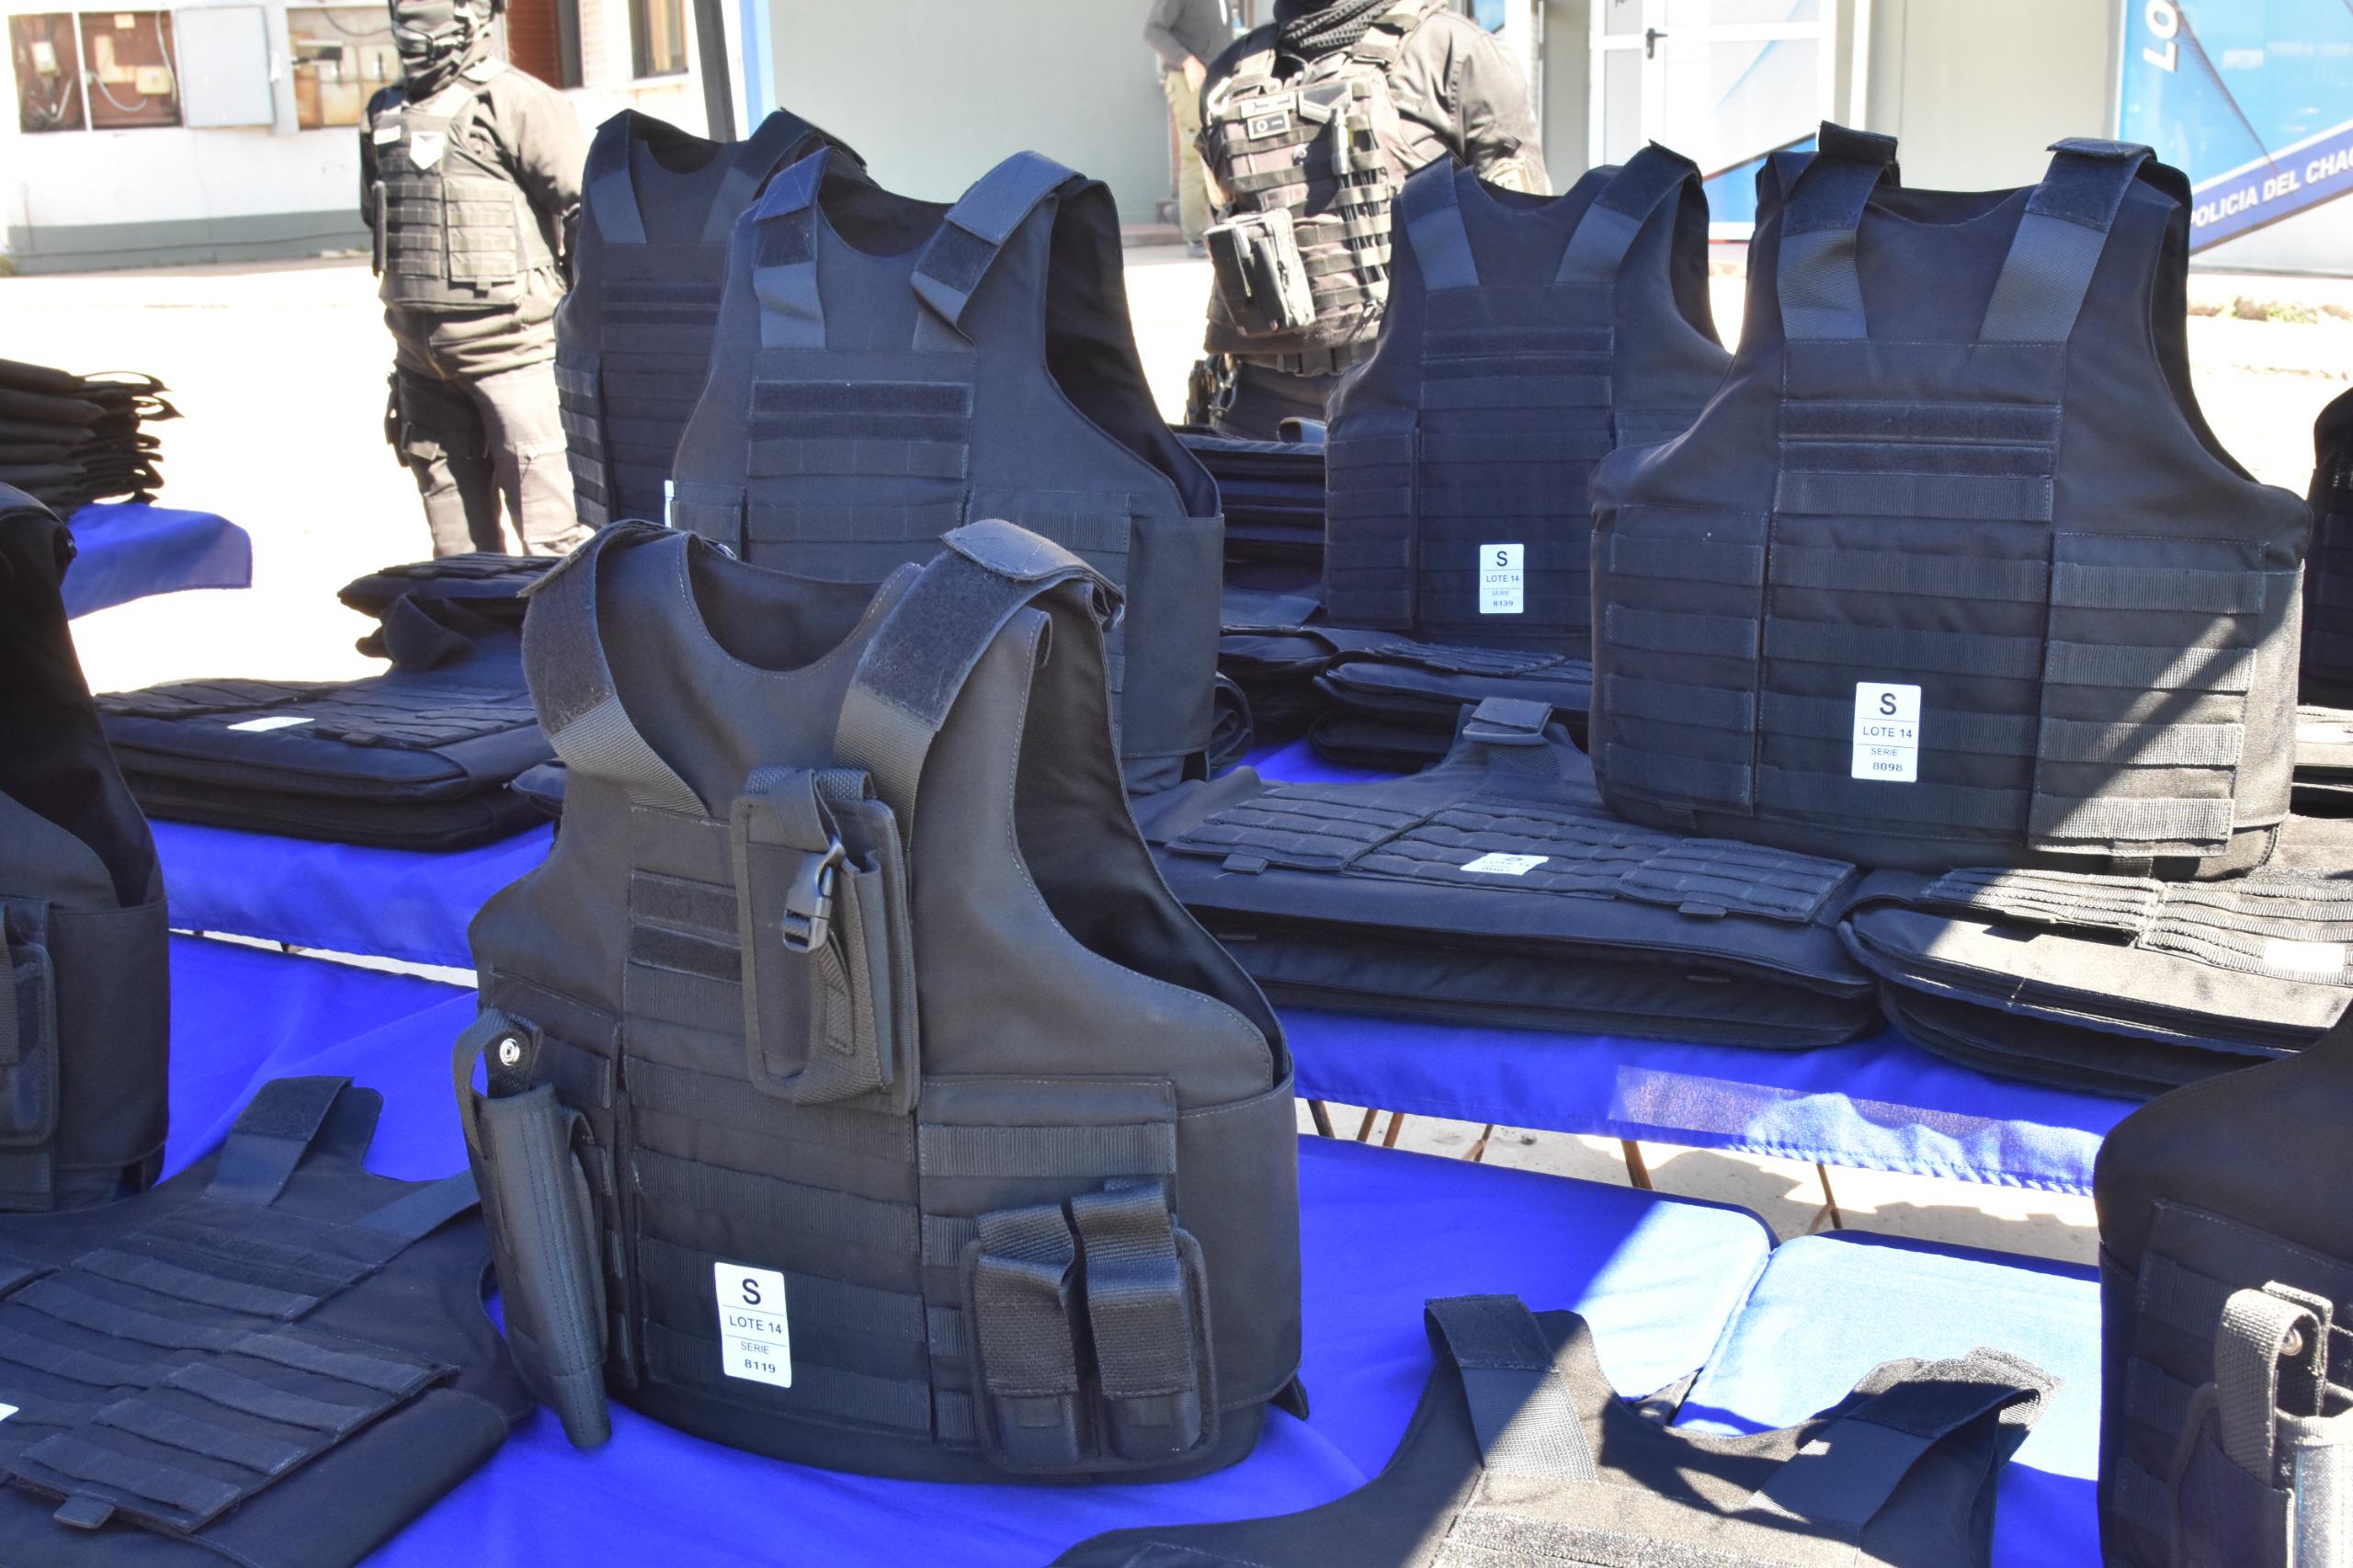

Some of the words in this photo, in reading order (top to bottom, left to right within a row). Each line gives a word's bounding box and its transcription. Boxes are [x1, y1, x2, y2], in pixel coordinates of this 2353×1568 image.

[2263, 170, 2302, 202] DEL
[1496, 551, 1508, 567] S
[1486, 574, 1508, 583] LOTE
[1880, 692, 1897, 715] S
[1862, 726, 1895, 738] LOTE
[1900, 728, 1913, 739] 14
[1870, 747, 1898, 756] SERIE
[1872, 762, 1903, 772] 8098
[742, 1278, 761, 1305] S
[729, 1314, 764, 1331] LOTE
[768, 1322, 782, 1335] 14
[740, 1341, 770, 1355] SERIE
[745, 1358, 776, 1373] 8119
